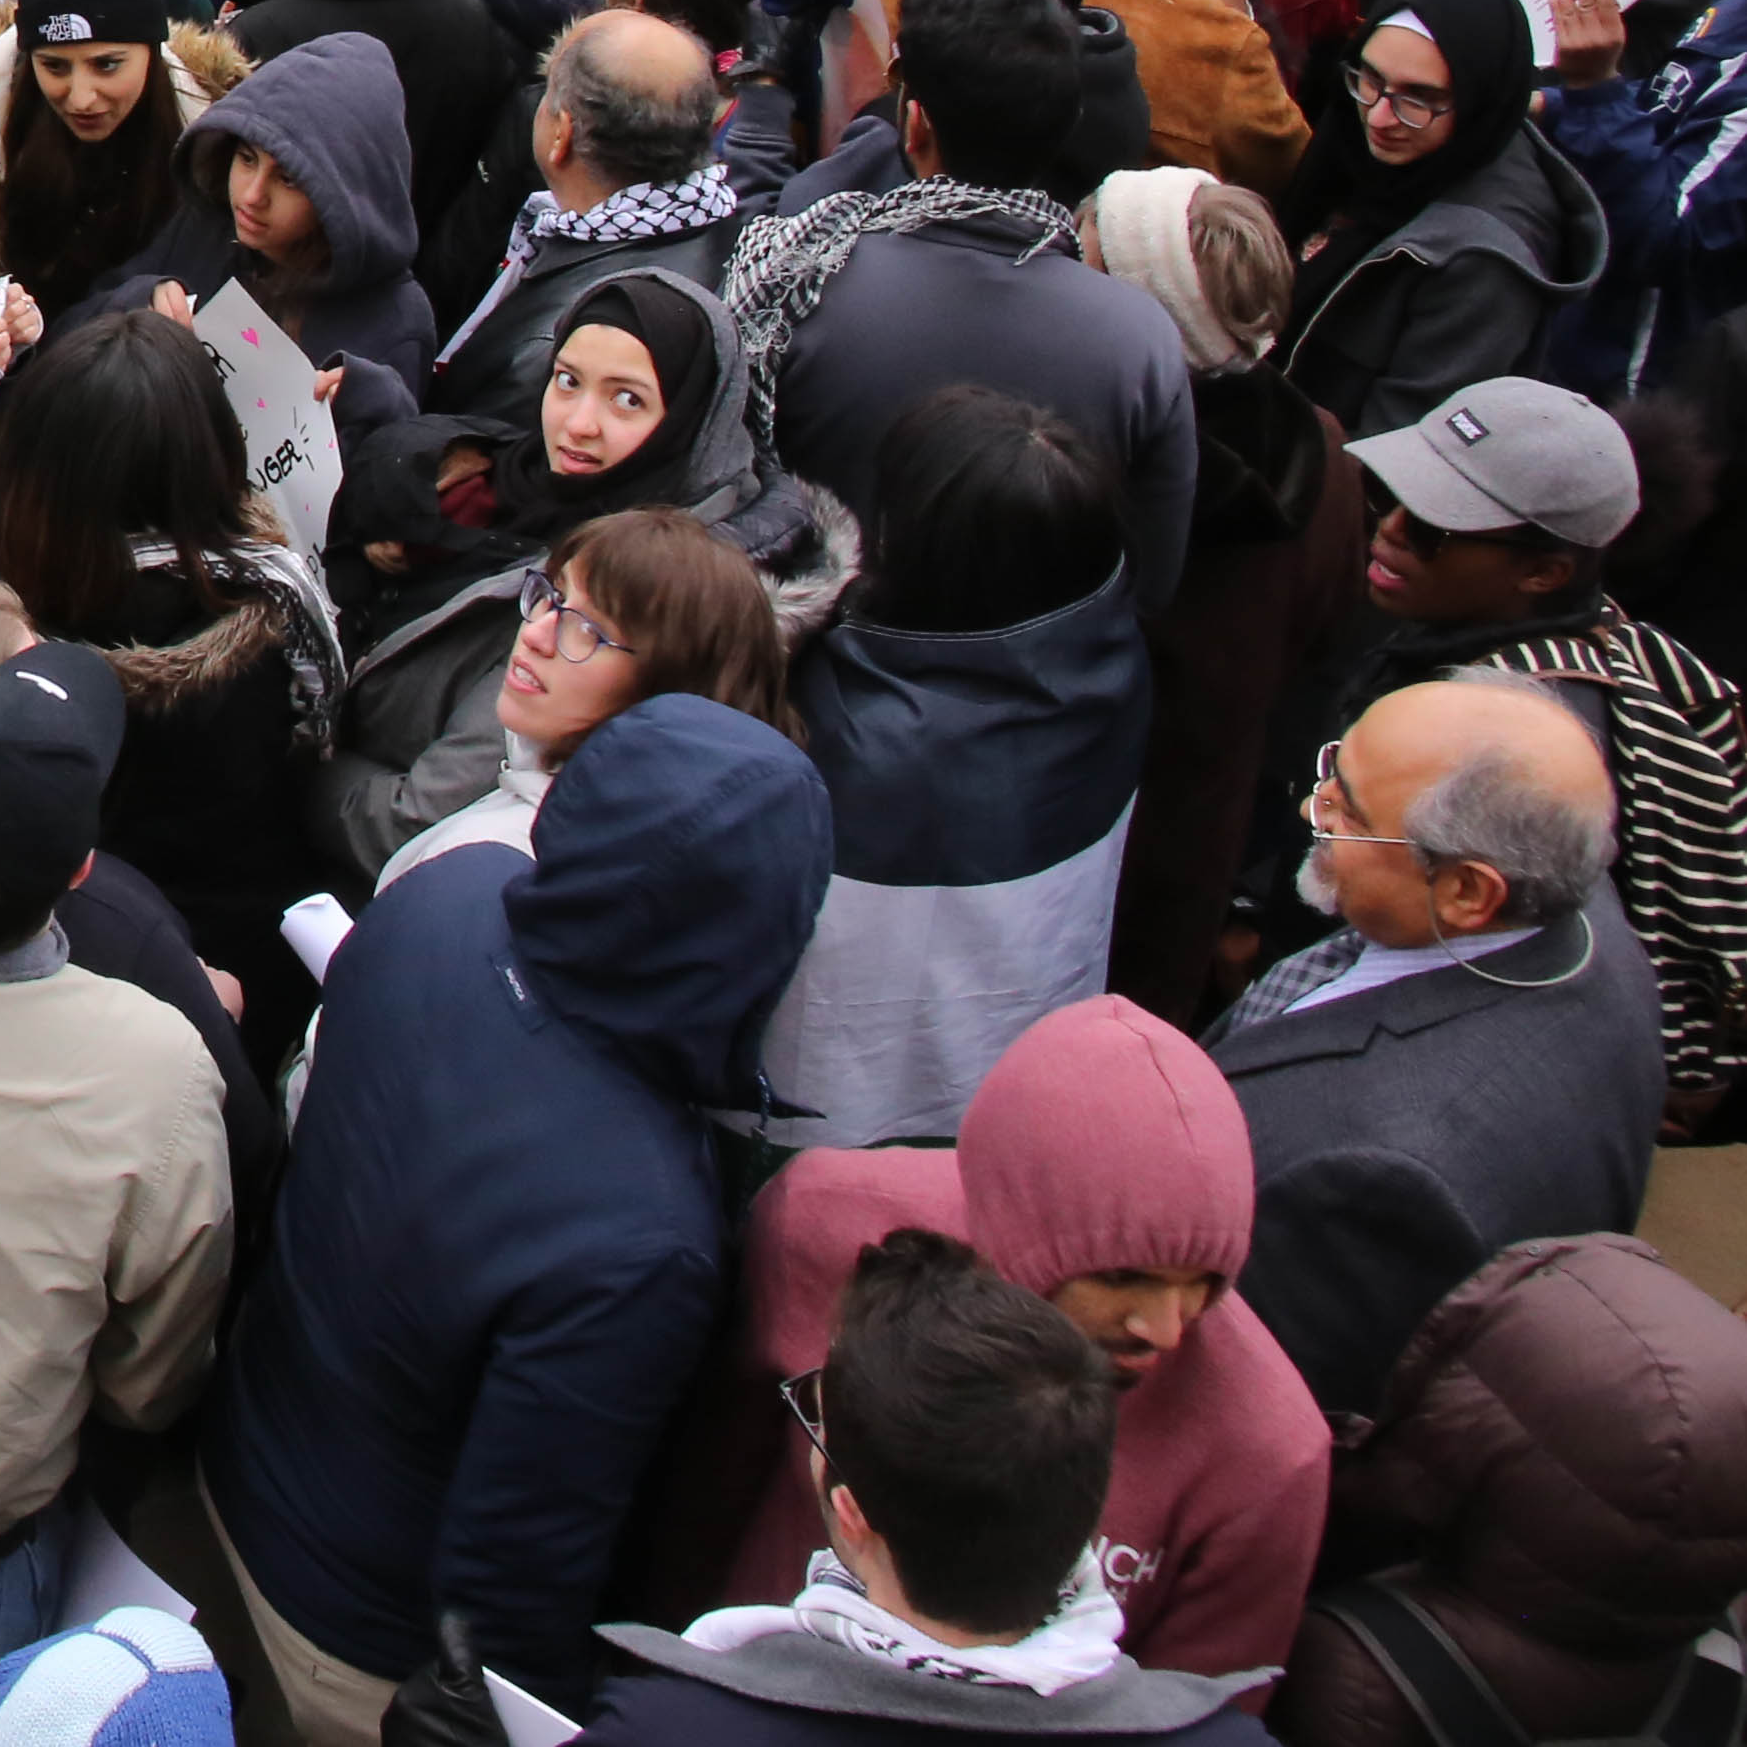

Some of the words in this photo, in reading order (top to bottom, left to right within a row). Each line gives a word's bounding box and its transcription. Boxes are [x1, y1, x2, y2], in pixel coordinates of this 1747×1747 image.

[48, 14, 70, 24] THE
[38, 23, 71, 33] NORTH
[46, 32, 73, 42] FACE
